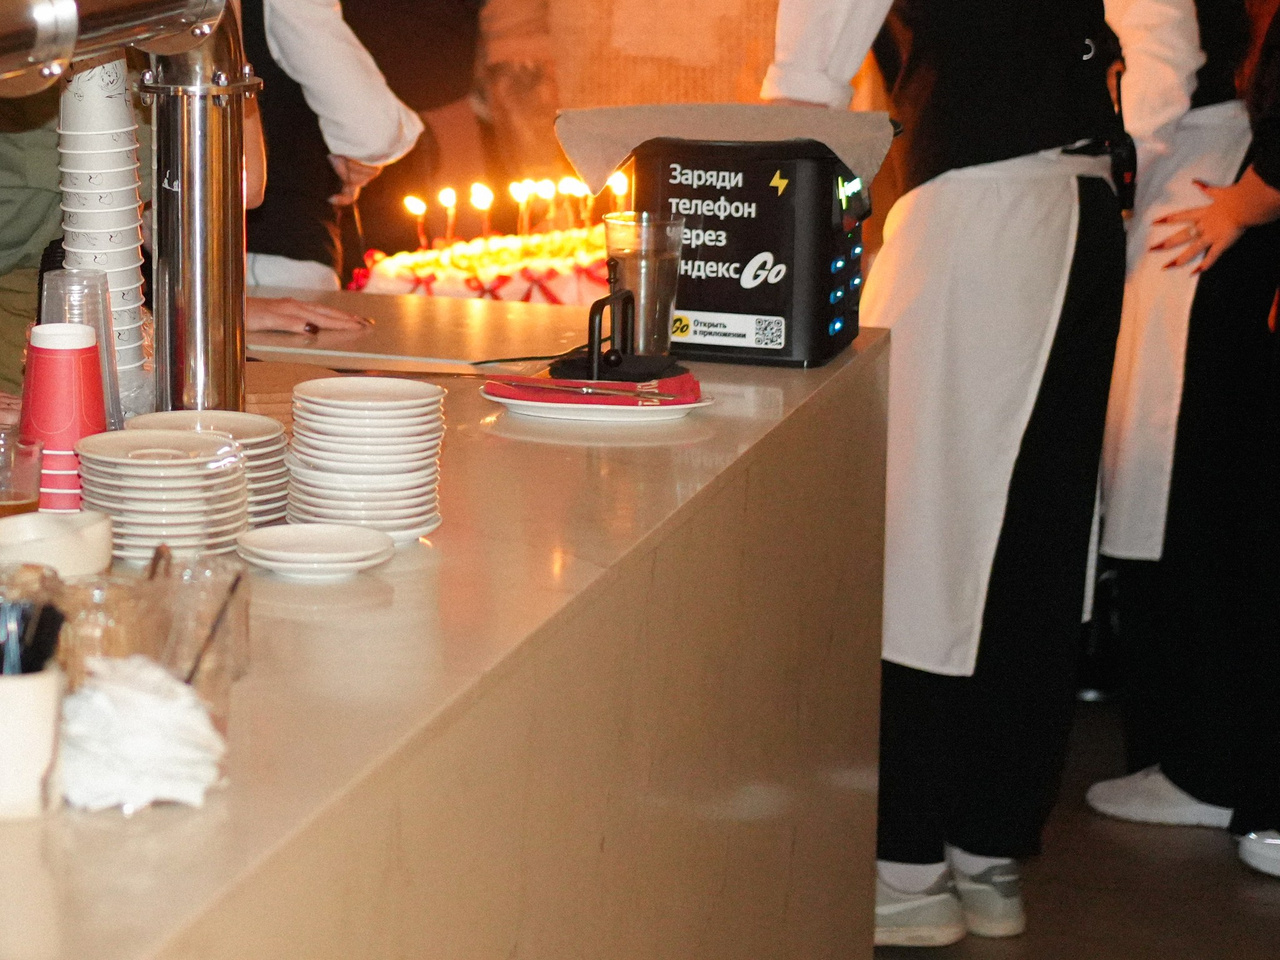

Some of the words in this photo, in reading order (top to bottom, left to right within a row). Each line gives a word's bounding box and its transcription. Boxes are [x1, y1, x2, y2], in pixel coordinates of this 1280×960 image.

[668, 163, 744, 190] Заряди
[668, 196, 757, 220] телефон
[679, 260, 740, 280] ндекс
[740, 251, 787, 289] Go
[693, 319, 727, 329] Открыть
